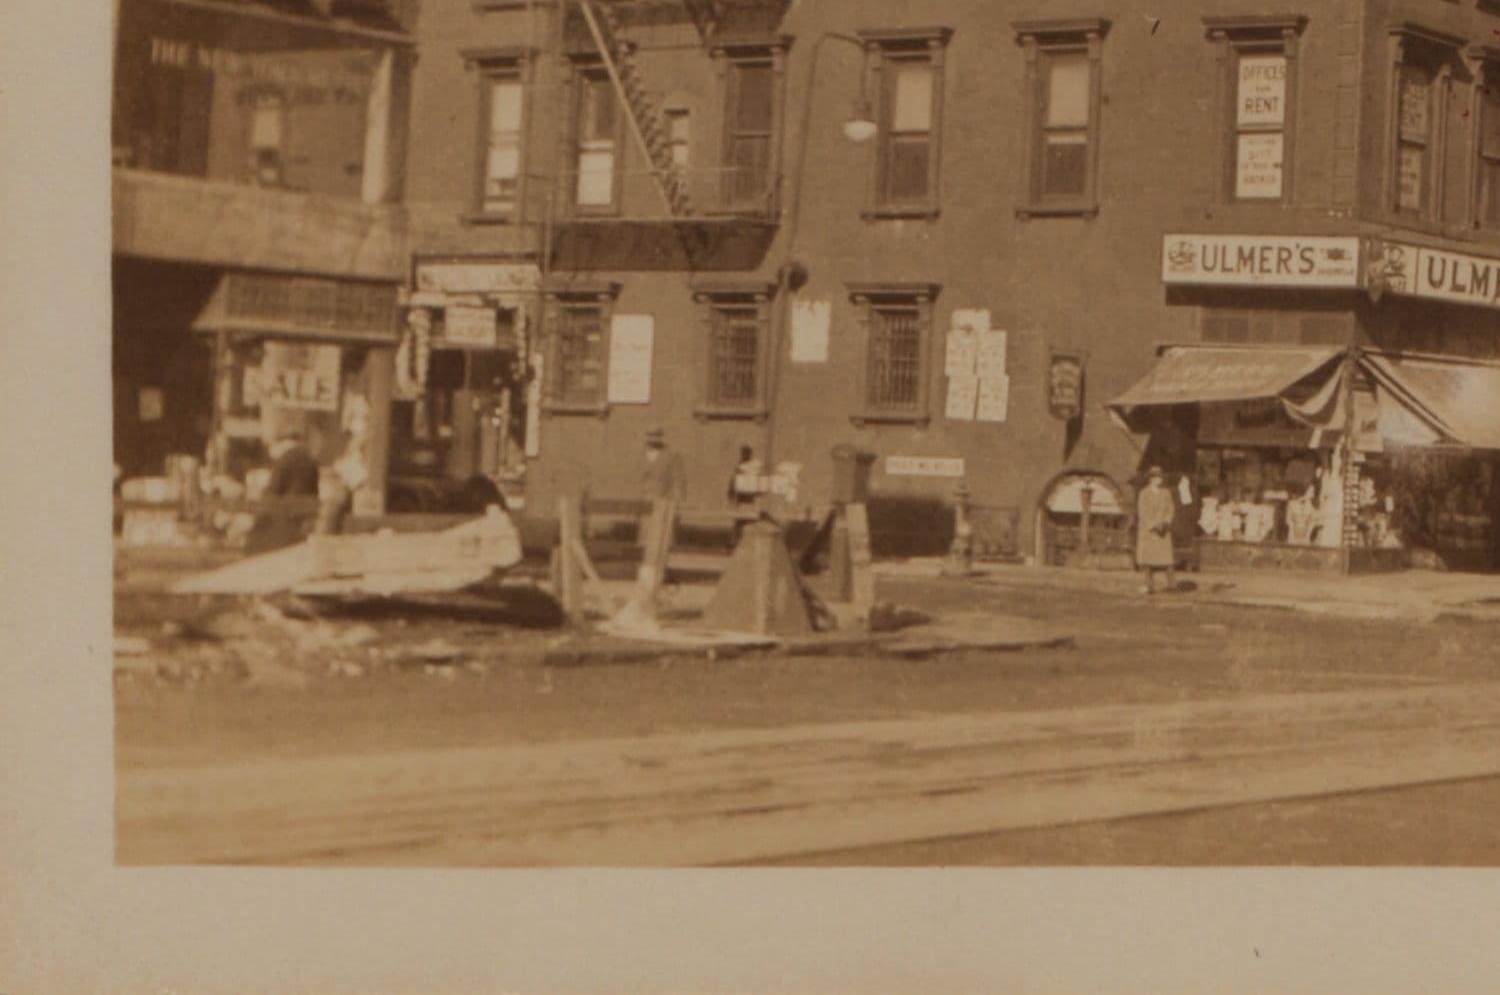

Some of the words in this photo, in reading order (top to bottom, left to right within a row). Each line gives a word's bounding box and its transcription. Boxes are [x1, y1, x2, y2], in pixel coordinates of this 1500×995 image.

[1242, 65, 1286, 81] OFFICES
[1245, 96, 1279, 113] RENT
[1200, 242, 1315, 275] ULMER'S
